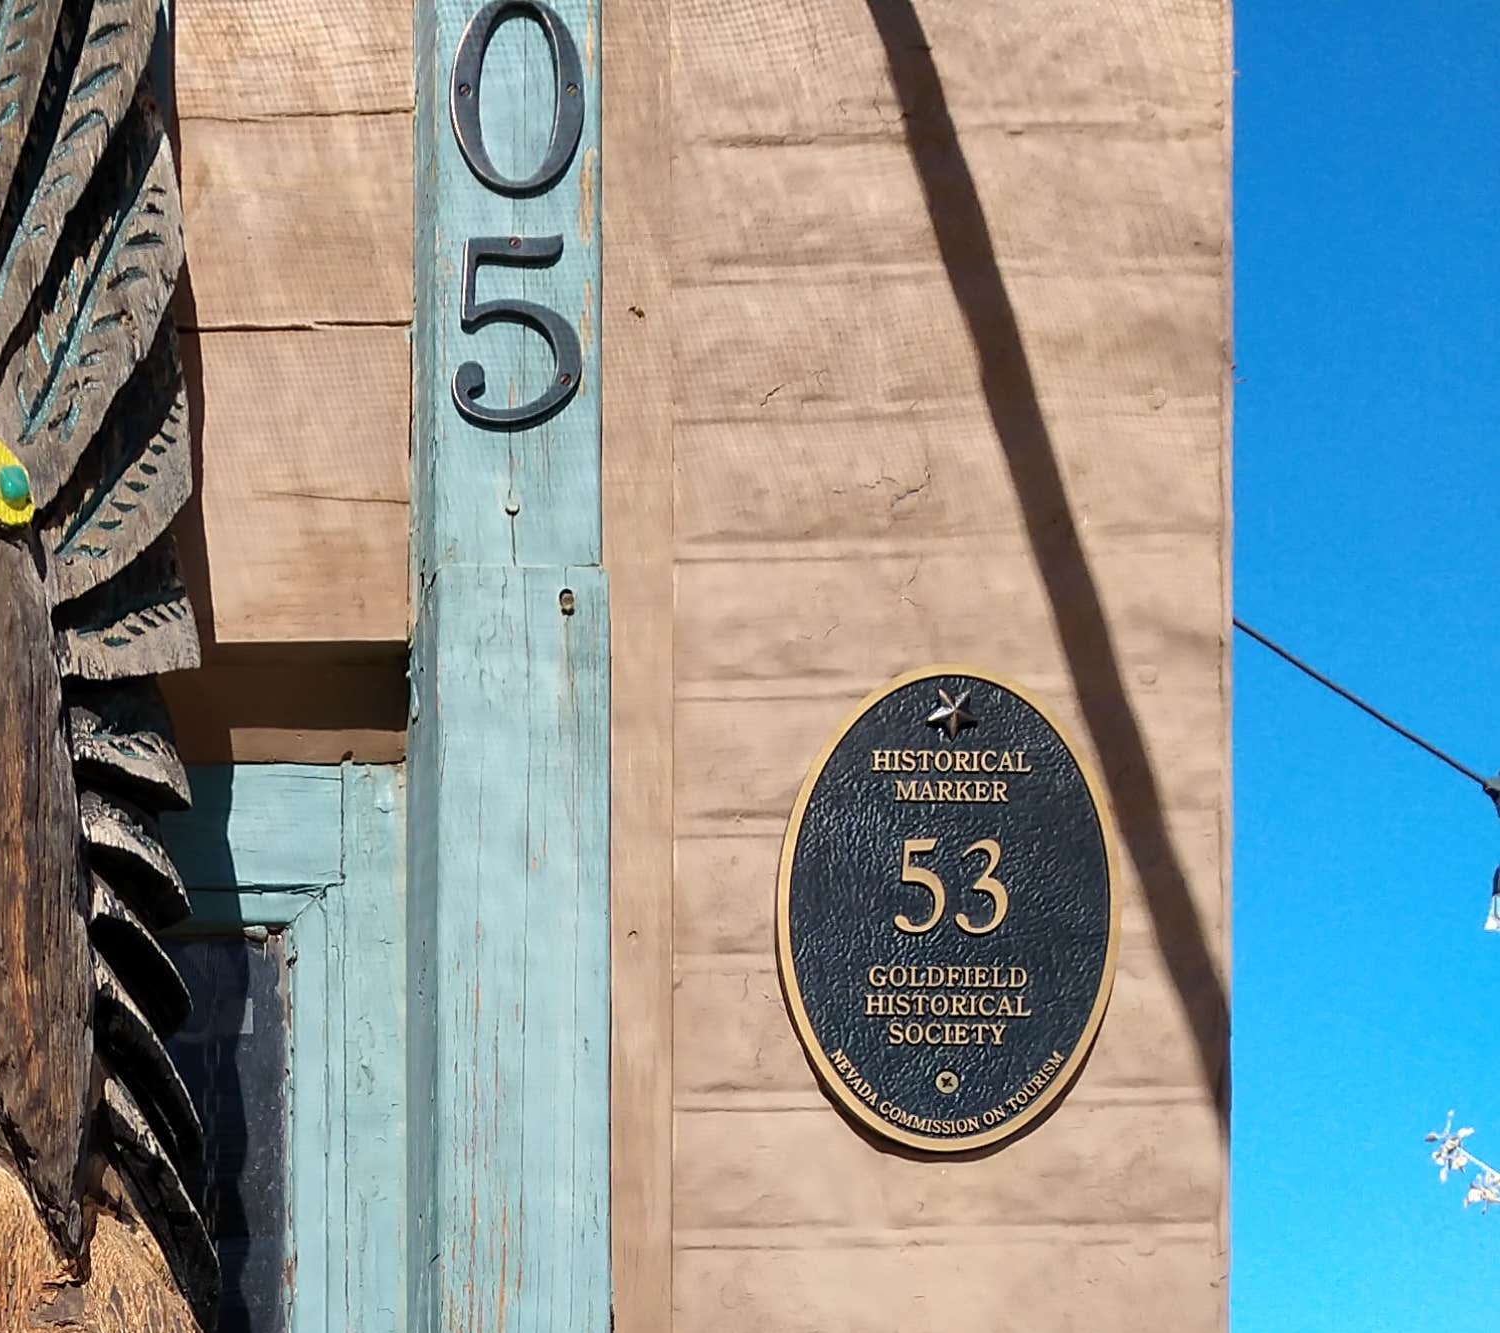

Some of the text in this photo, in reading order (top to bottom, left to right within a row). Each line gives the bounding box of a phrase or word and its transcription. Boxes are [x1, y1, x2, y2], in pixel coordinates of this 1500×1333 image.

[871, 750, 1032, 773] HISTORICAL
[895, 780, 1009, 802] MARKER
[892, 838, 1010, 936] 53
[867, 965, 1029, 989] GOLDFIELD
[864, 994, 1032, 1017] HISTORICAL
[888, 1022, 1004, 1046] SOCIETY
[830, 1047, 1066, 1135] NEVADA COMMISSION ON TOURISM
